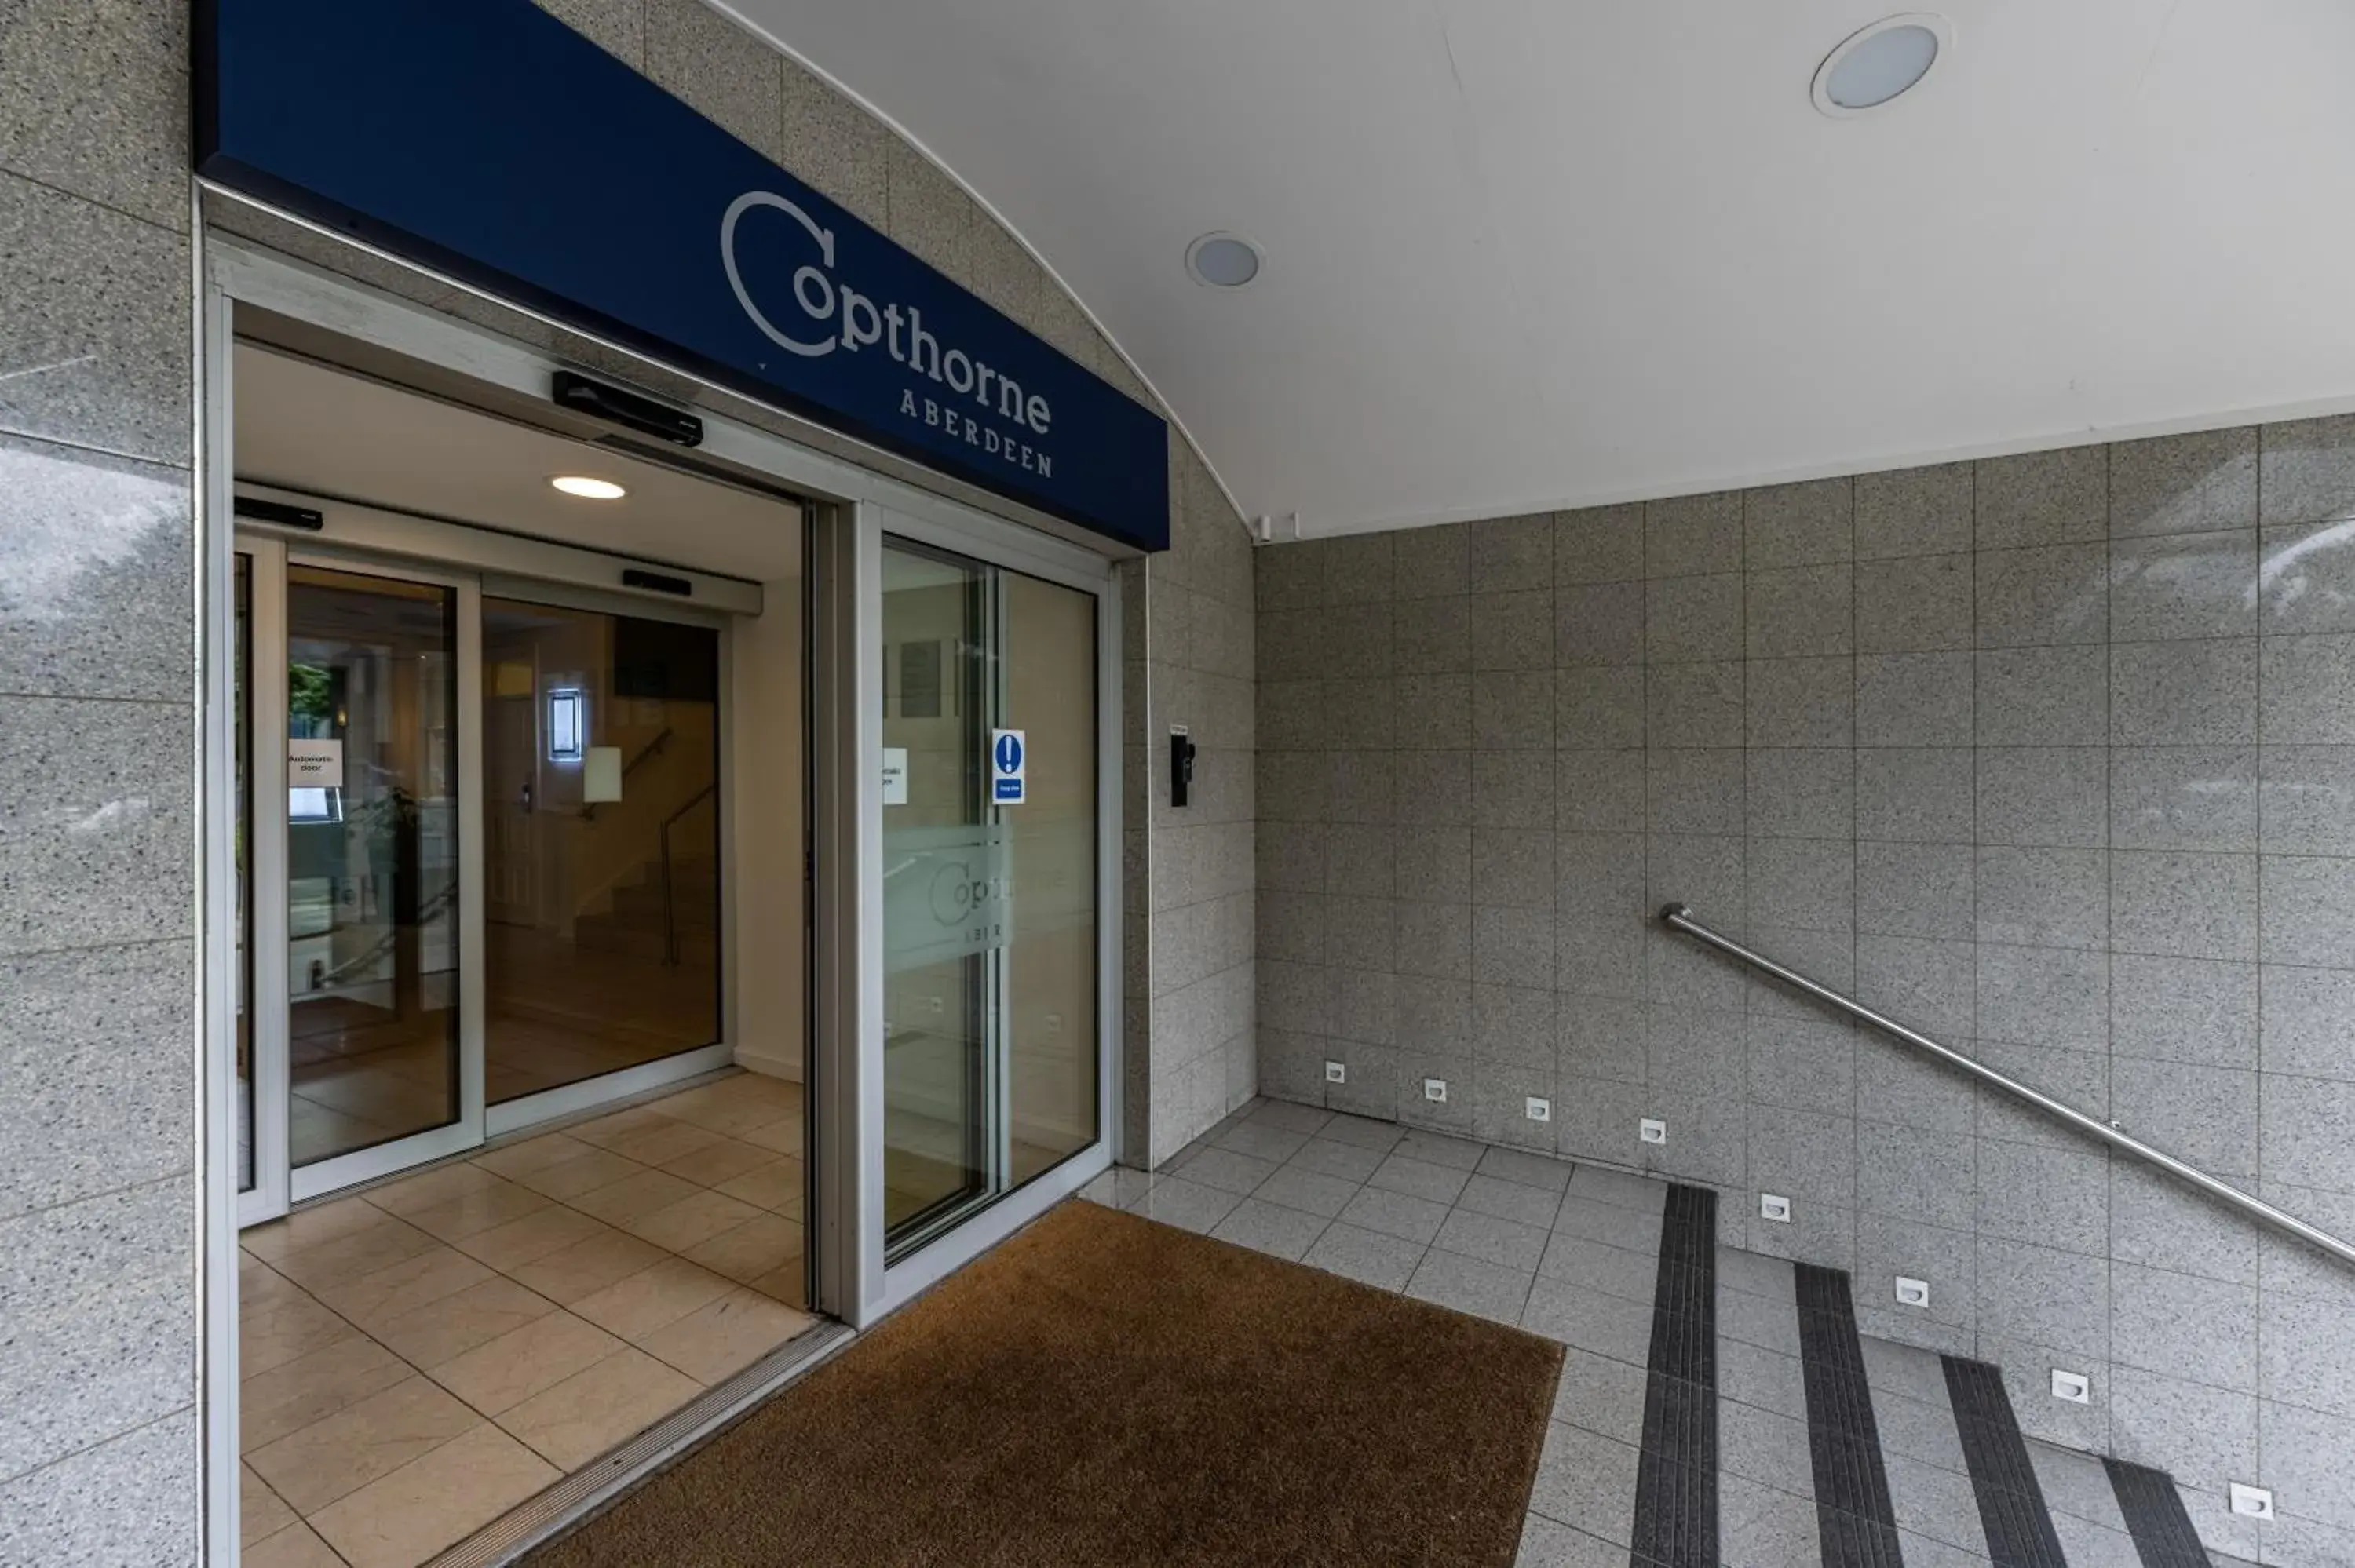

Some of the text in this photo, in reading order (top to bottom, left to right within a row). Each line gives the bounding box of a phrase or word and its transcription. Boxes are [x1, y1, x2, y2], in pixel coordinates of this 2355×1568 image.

[721, 191, 1052, 434] Copthorne
[900, 388, 1053, 479] ABERDEEN
[288, 754, 334, 763] Automat
